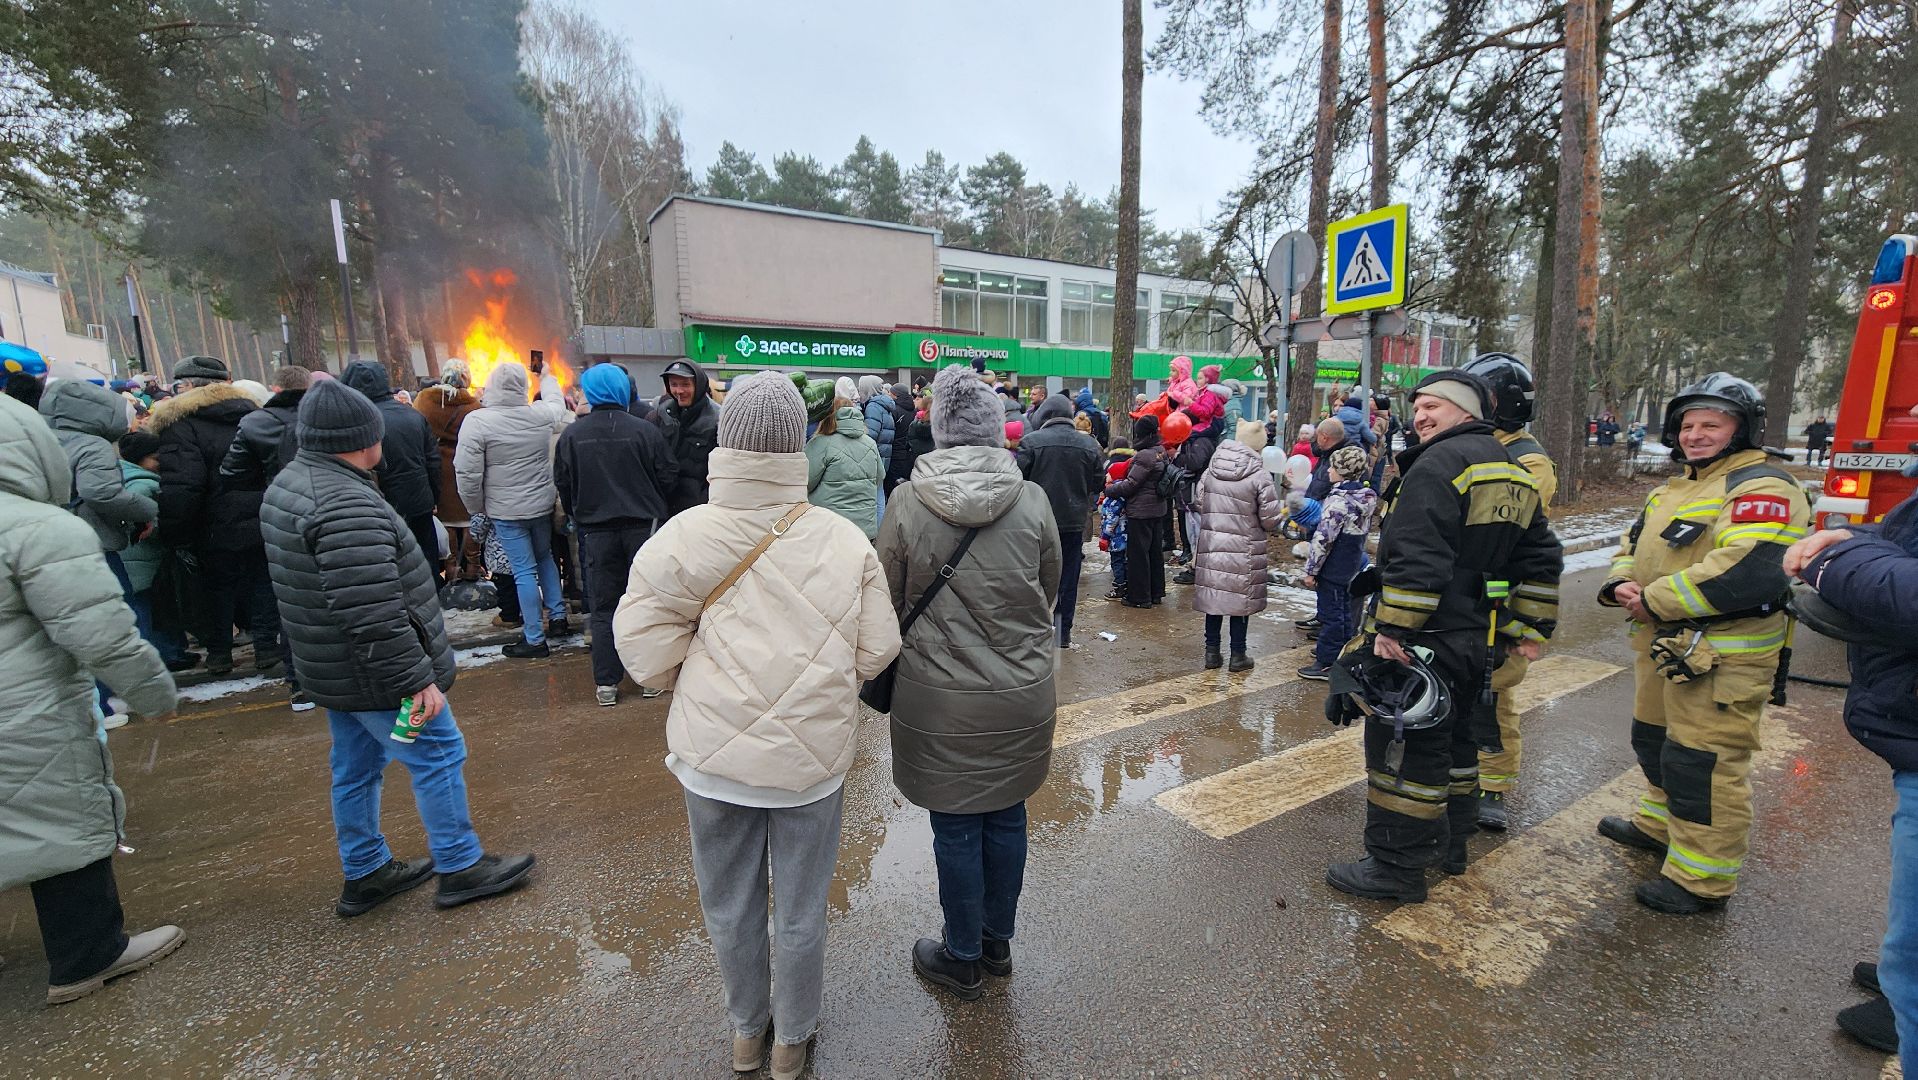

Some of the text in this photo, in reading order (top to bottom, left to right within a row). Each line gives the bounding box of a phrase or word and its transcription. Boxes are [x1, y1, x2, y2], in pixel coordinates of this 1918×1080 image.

[759, 340, 866, 357] здесь аптека
[1735, 501, 1786, 517] РТП
[1674, 523, 1694, 538] 7
